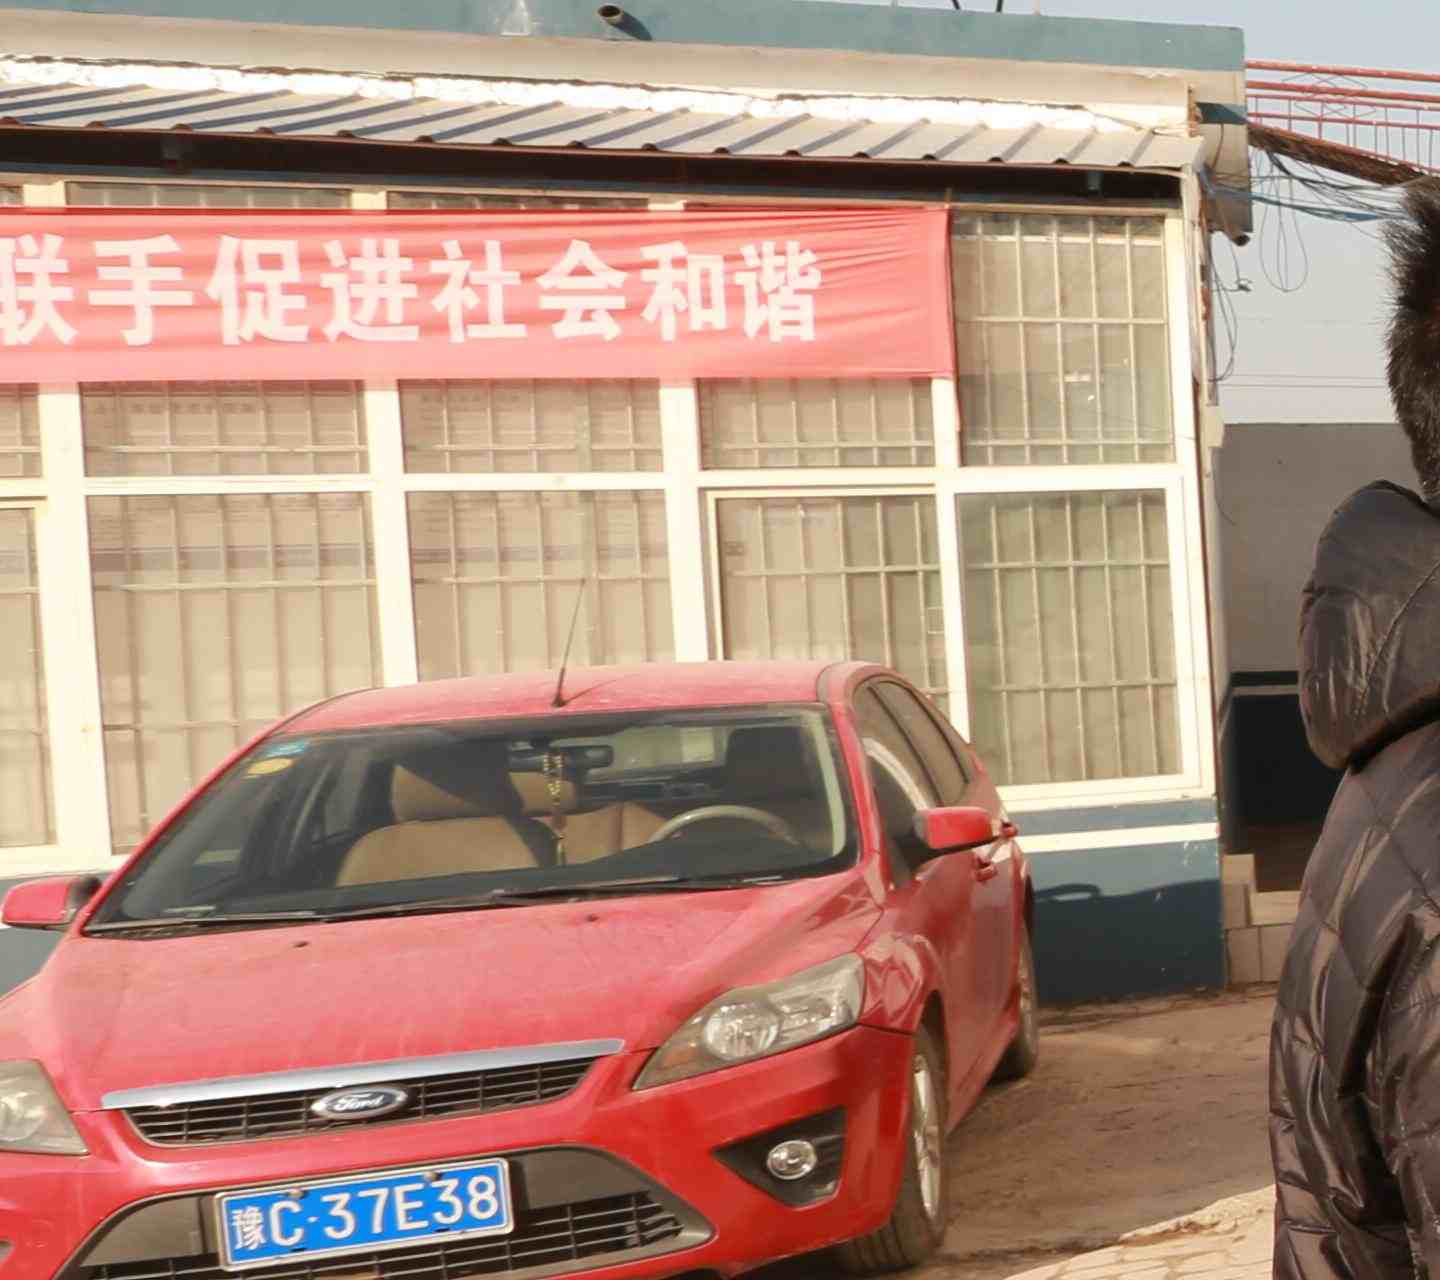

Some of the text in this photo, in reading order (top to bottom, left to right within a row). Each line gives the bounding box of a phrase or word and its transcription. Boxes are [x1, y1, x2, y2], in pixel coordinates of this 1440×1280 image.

[0, 233, 823, 346] 联手促进社会和谐
[333, 1091, 384, 1112] Ford
